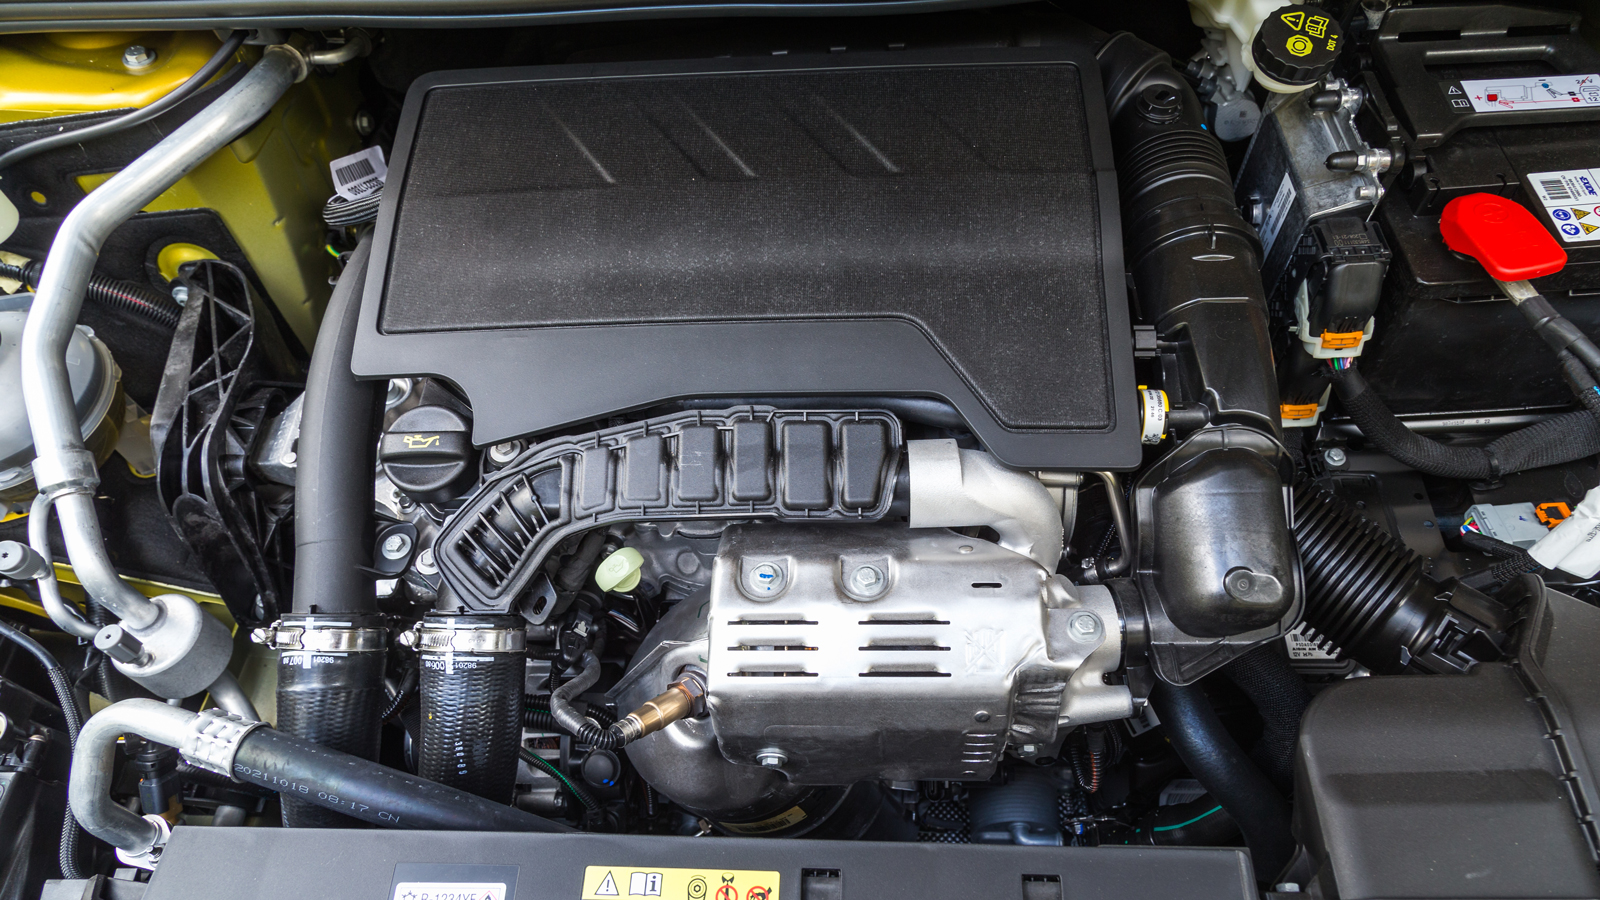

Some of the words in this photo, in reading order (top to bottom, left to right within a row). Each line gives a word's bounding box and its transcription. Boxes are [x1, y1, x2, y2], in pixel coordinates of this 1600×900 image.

[1326, 39, 1337, 51] DOT
[1578, 175, 1598, 197] EXIDE
[313, 656, 335, 664] 98201
[455, 661, 478, 669] 98201
[233, 763, 309, 794] 20211018
[318, 791, 369, 813] 08:17
[378, 811, 400, 824] CN
